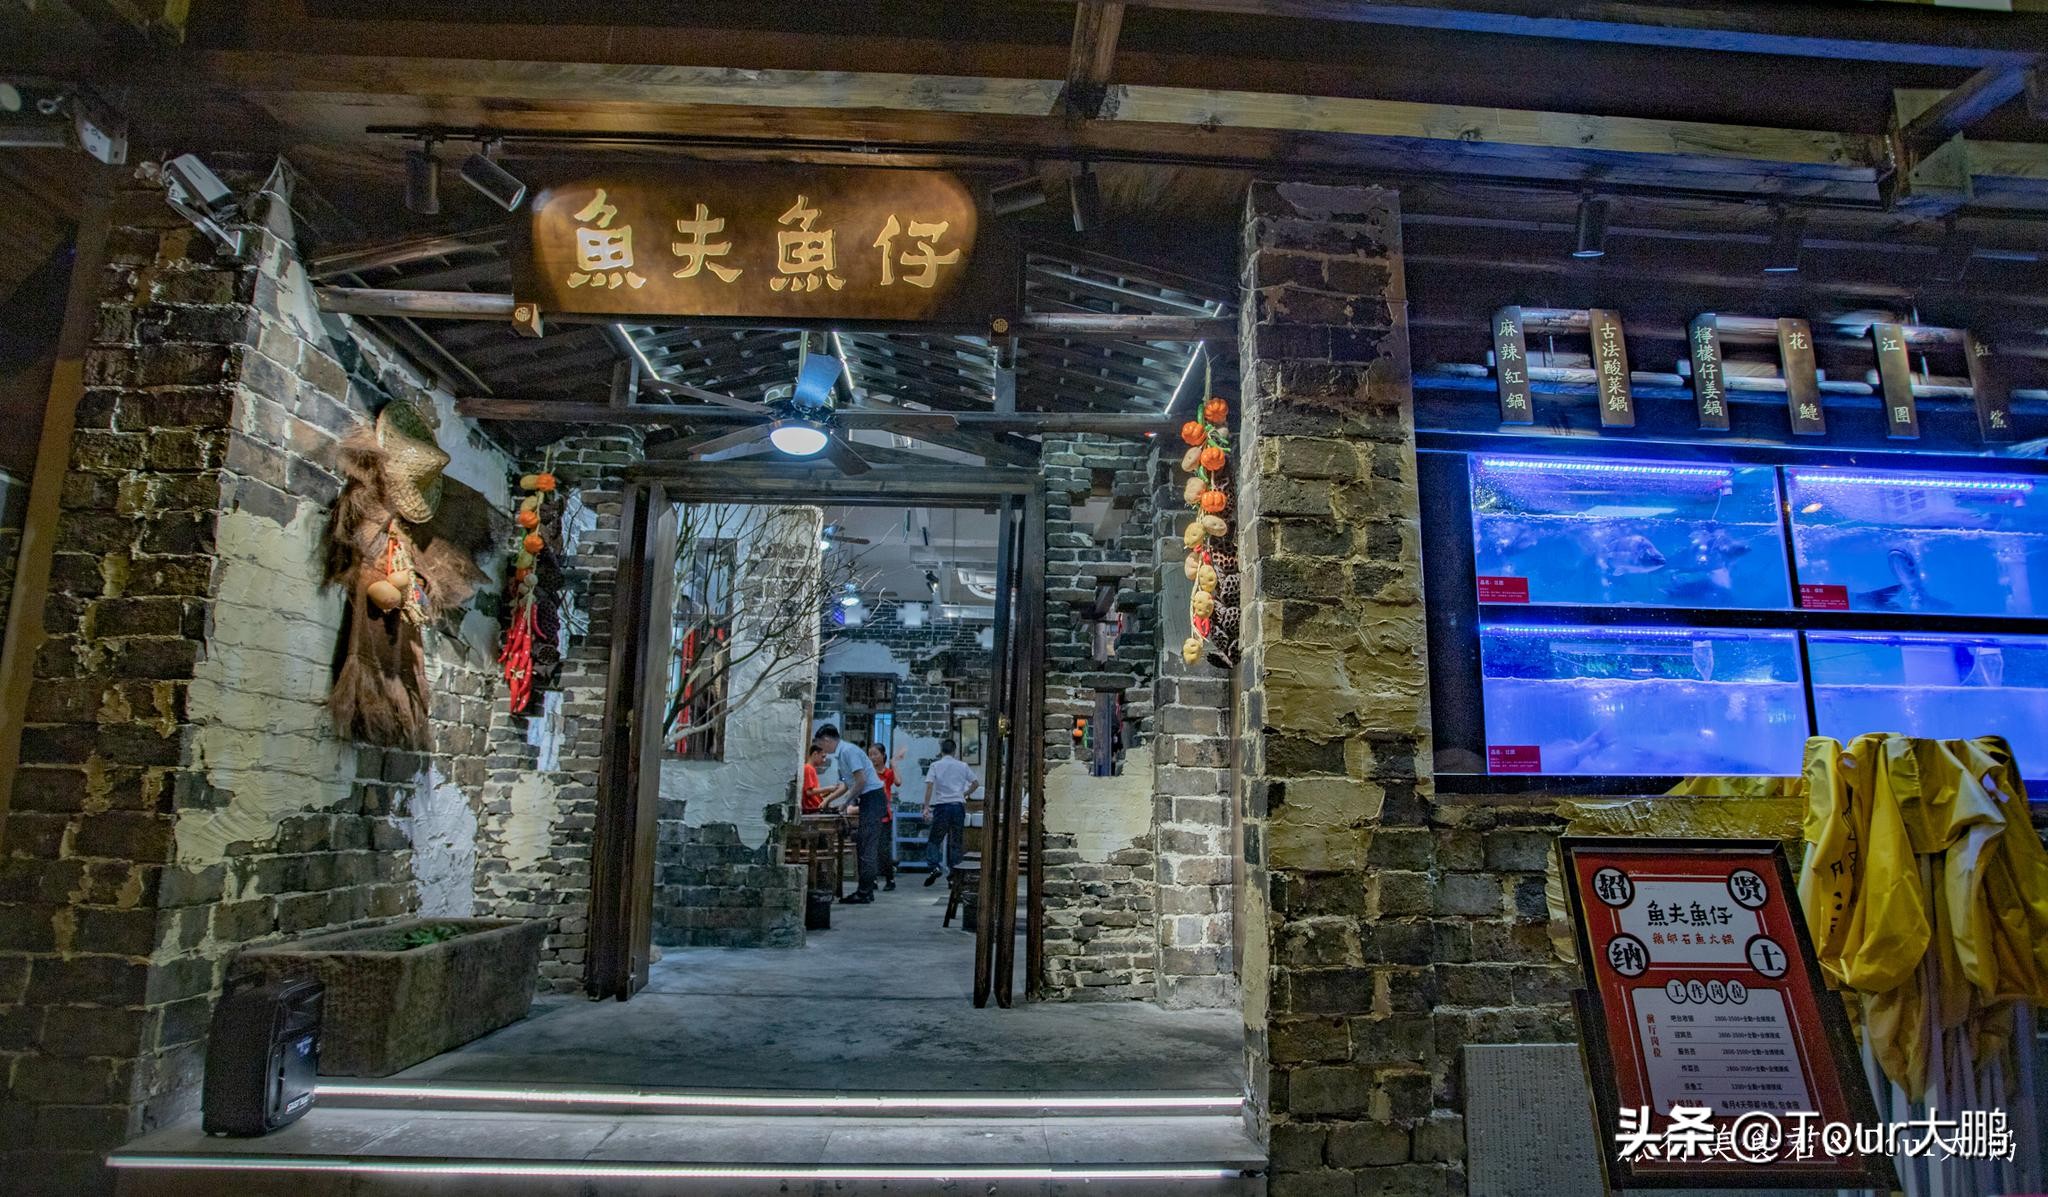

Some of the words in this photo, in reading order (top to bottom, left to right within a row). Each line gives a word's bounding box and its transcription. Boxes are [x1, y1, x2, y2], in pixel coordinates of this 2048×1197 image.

[567, 187, 961, 292] 魚夫魚仔
[1498, 319, 1527, 410] 麻辣紅鍋
[1599, 322, 1629, 412] 古法酸菜鍋
[1599, 874, 1627, 899] 招
[1733, 875, 1763, 902] 贤
[1647, 900, 1733, 927] 魚夫魚仔
[1612, 942, 1644, 970] 纳
[1671, 983, 1745, 999] 工作岗位
